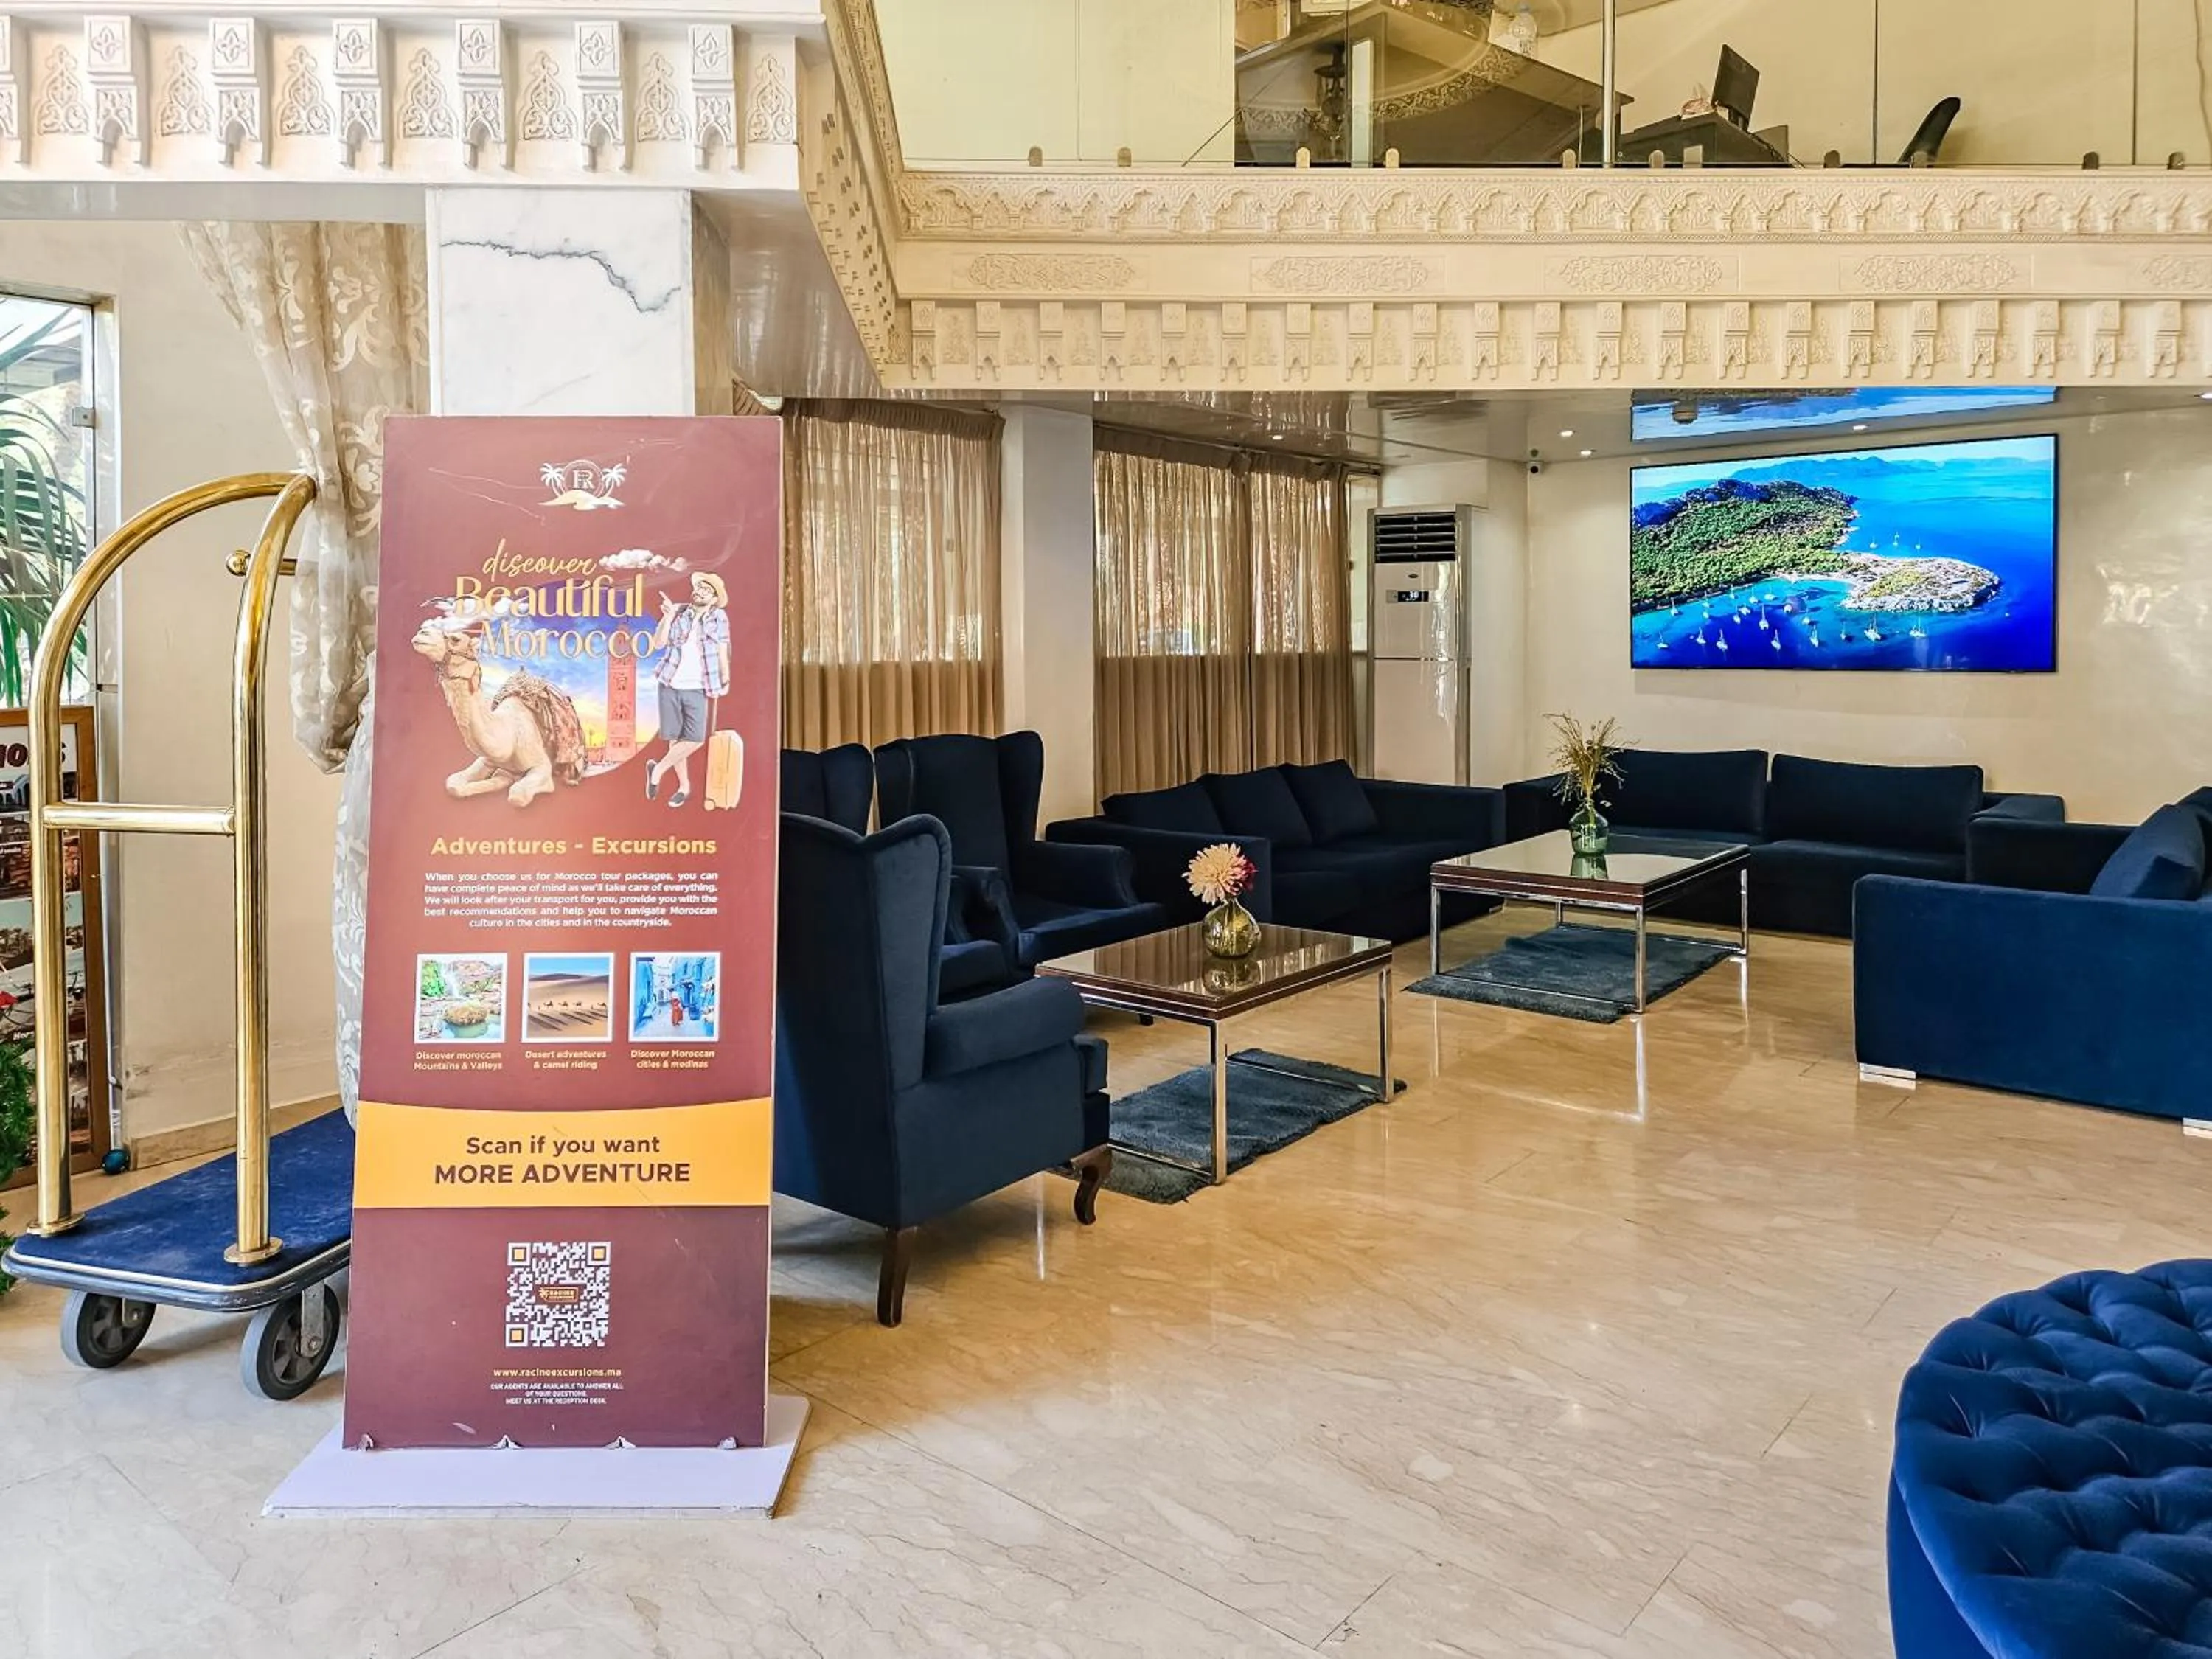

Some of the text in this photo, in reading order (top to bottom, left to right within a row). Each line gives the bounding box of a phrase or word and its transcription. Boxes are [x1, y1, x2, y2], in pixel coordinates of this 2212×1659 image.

[482, 538, 597, 582] discover
[454, 573, 643, 618] Beautiful
[480, 619, 655, 658] Morocco
[431, 836, 567, 855] Adventures
[592, 835, 717, 854] Excursions
[425, 873, 453, 881] When
[459, 874, 477, 882] you
[481, 873, 516, 881] choose
[625, 872, 674, 882] packages,
[424, 885, 449, 893] have
[451, 885, 495, 894] complete
[498, 886, 527, 894] peace
[605, 883, 626, 891] take
[652, 883, 663, 891] of
[664, 883, 717, 894] everything.
[424, 894, 718, 905] We will look after your transport for you, provide you with the
[424, 906, 717, 916] best recommendations and help you to navigate Moroccan
[469, 917, 672, 928] culture in the cities and in the countryside.
[416, 1051, 501, 1060] Discover moroccan
[525, 1050, 606, 1058] Desert adventures
[631, 1050, 669, 1058] Discover
[414, 1061, 459, 1070] Mountains
[470, 1061, 502, 1071] Valleys
[542, 1060, 568, 1068] camel
[571, 1060, 597, 1070] riding
[636, 1060, 661, 1068] cities
[671, 1060, 708, 1068] medinas
[467, 1135, 660, 1157] Scan if you want
[435, 1163, 690, 1183] MORE ADVENTURE
[493, 1368, 622, 1377] www.racineexcursions.ma
